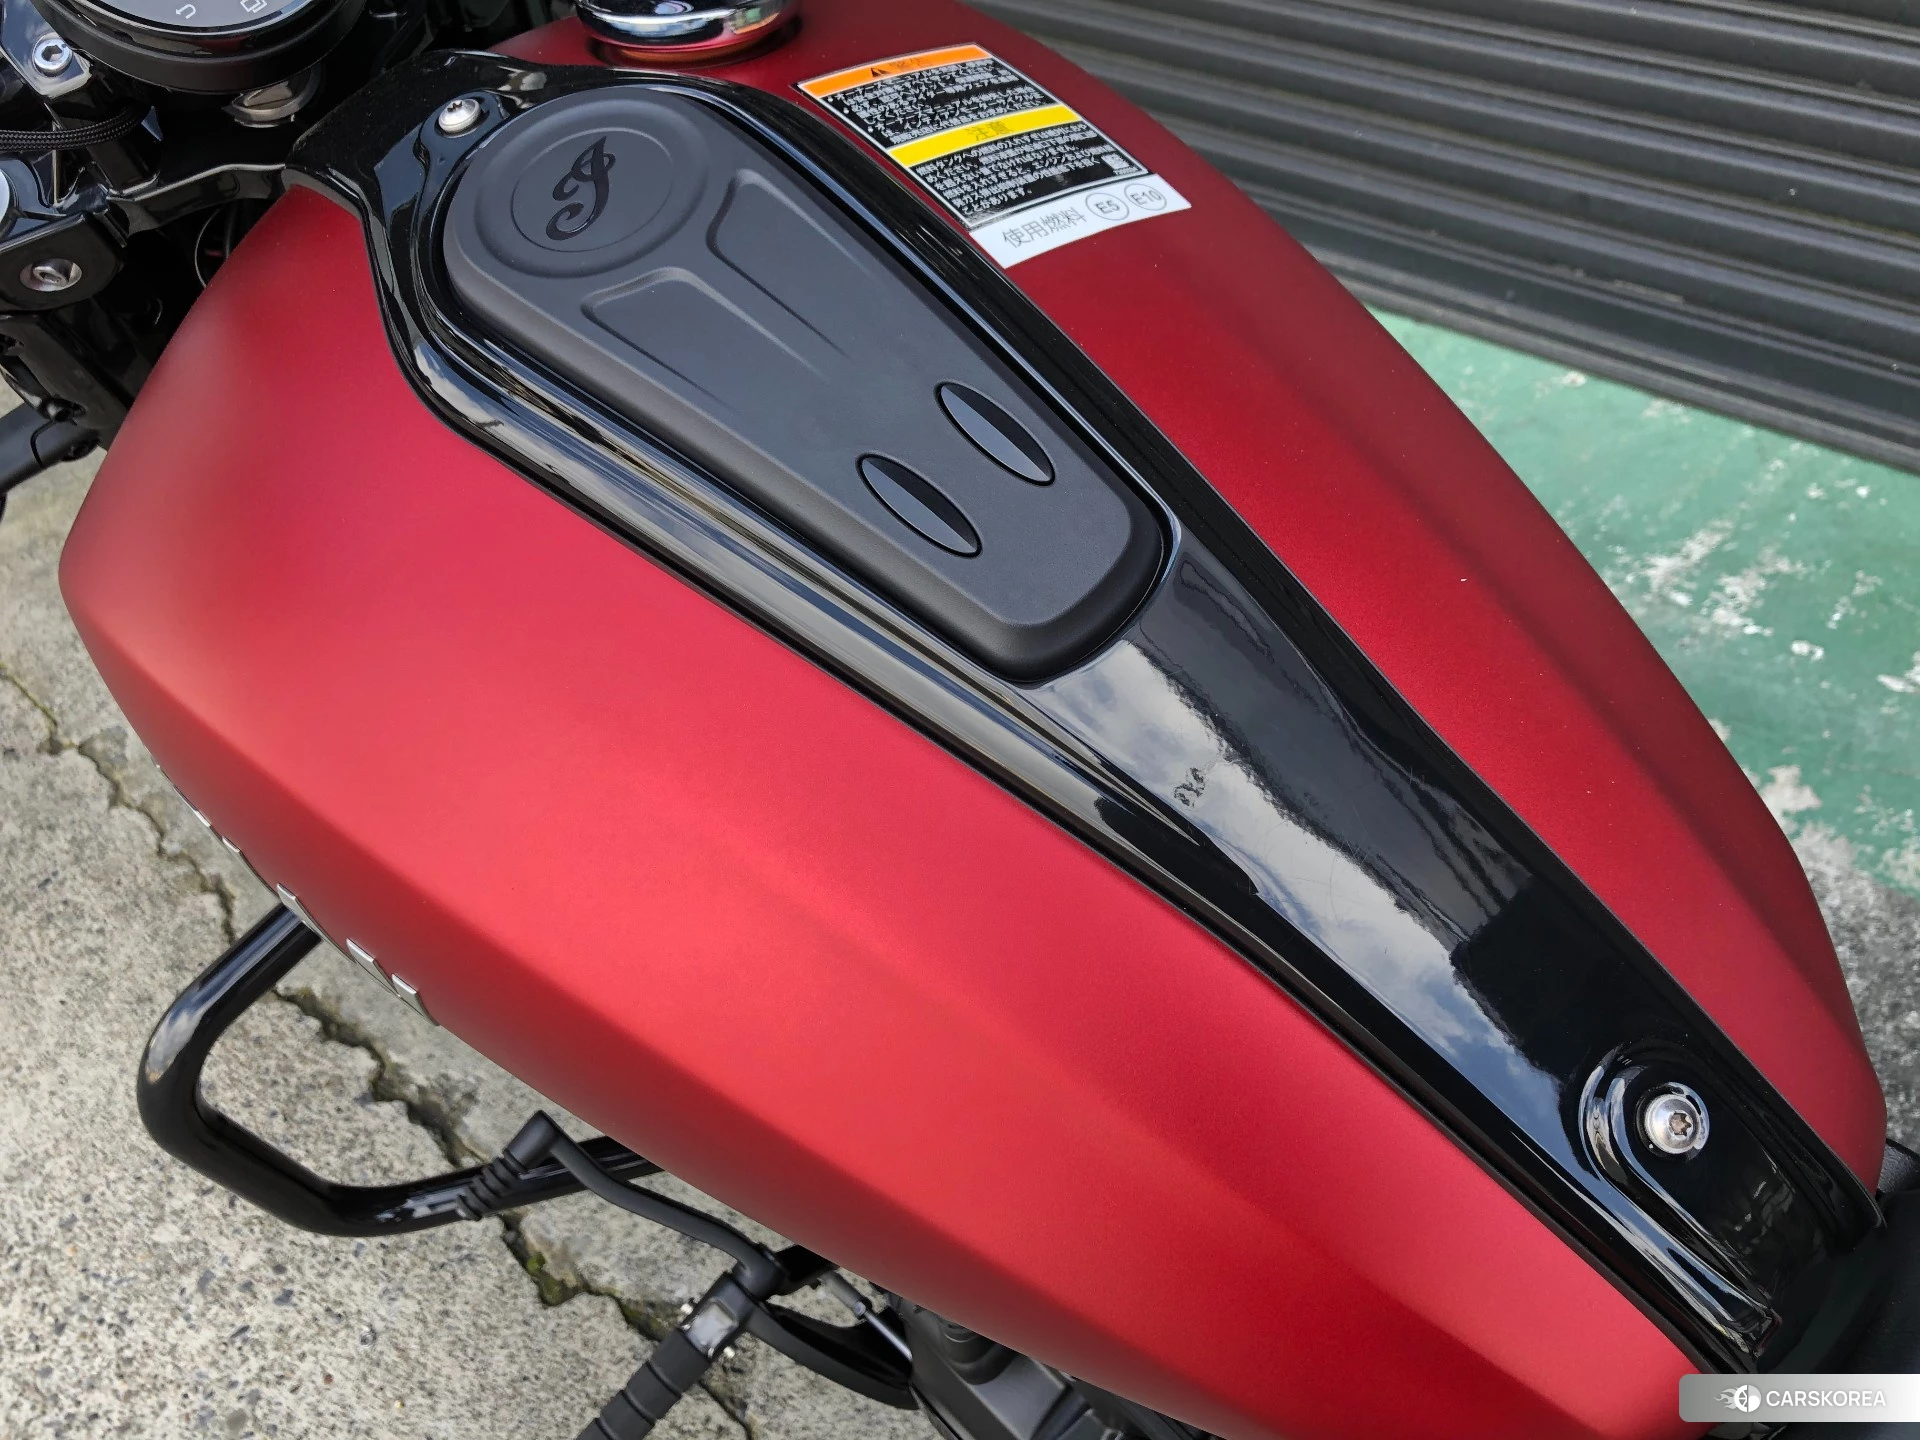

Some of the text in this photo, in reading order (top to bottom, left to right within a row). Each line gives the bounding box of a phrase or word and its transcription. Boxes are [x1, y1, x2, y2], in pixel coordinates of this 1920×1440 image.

[966, 120, 1014, 141] 注意
[1002, 187, 1163, 249] 使用燃料 E5 E10
